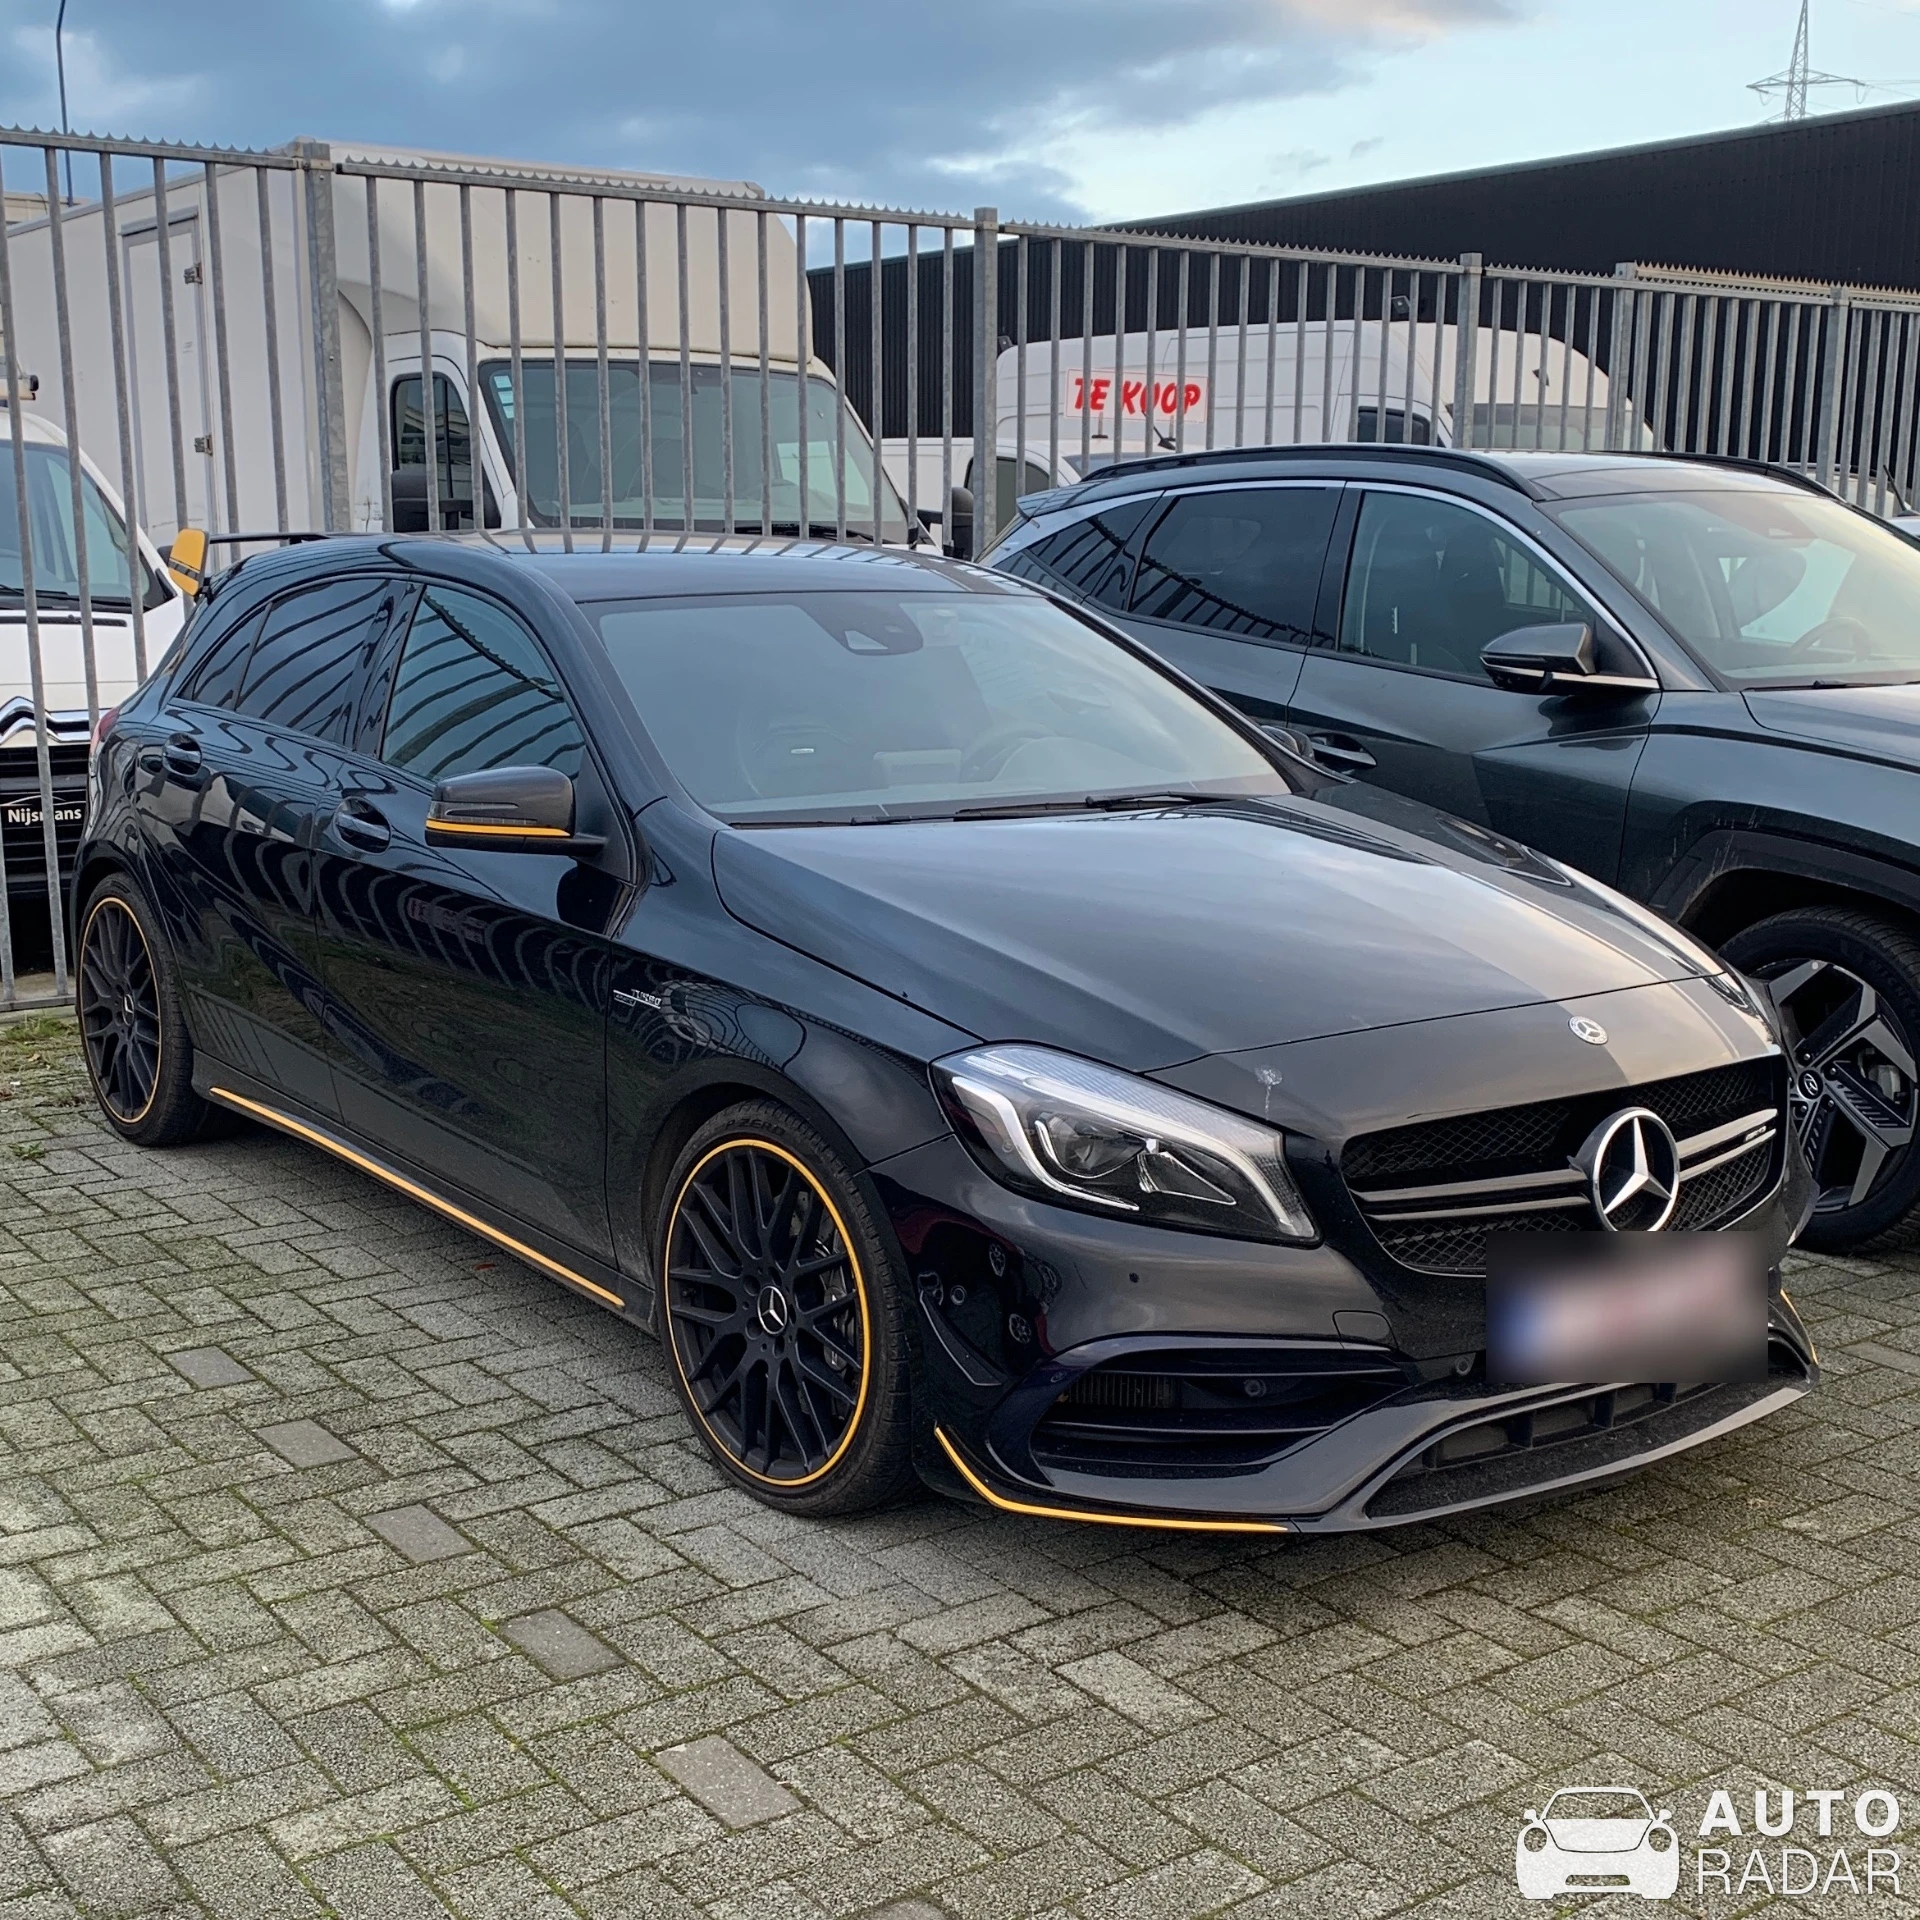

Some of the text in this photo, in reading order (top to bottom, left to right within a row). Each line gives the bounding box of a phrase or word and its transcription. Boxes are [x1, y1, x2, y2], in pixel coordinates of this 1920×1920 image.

[1074, 378, 1201, 415] TE KOOP
[8, 808, 82, 826] Nijsans
